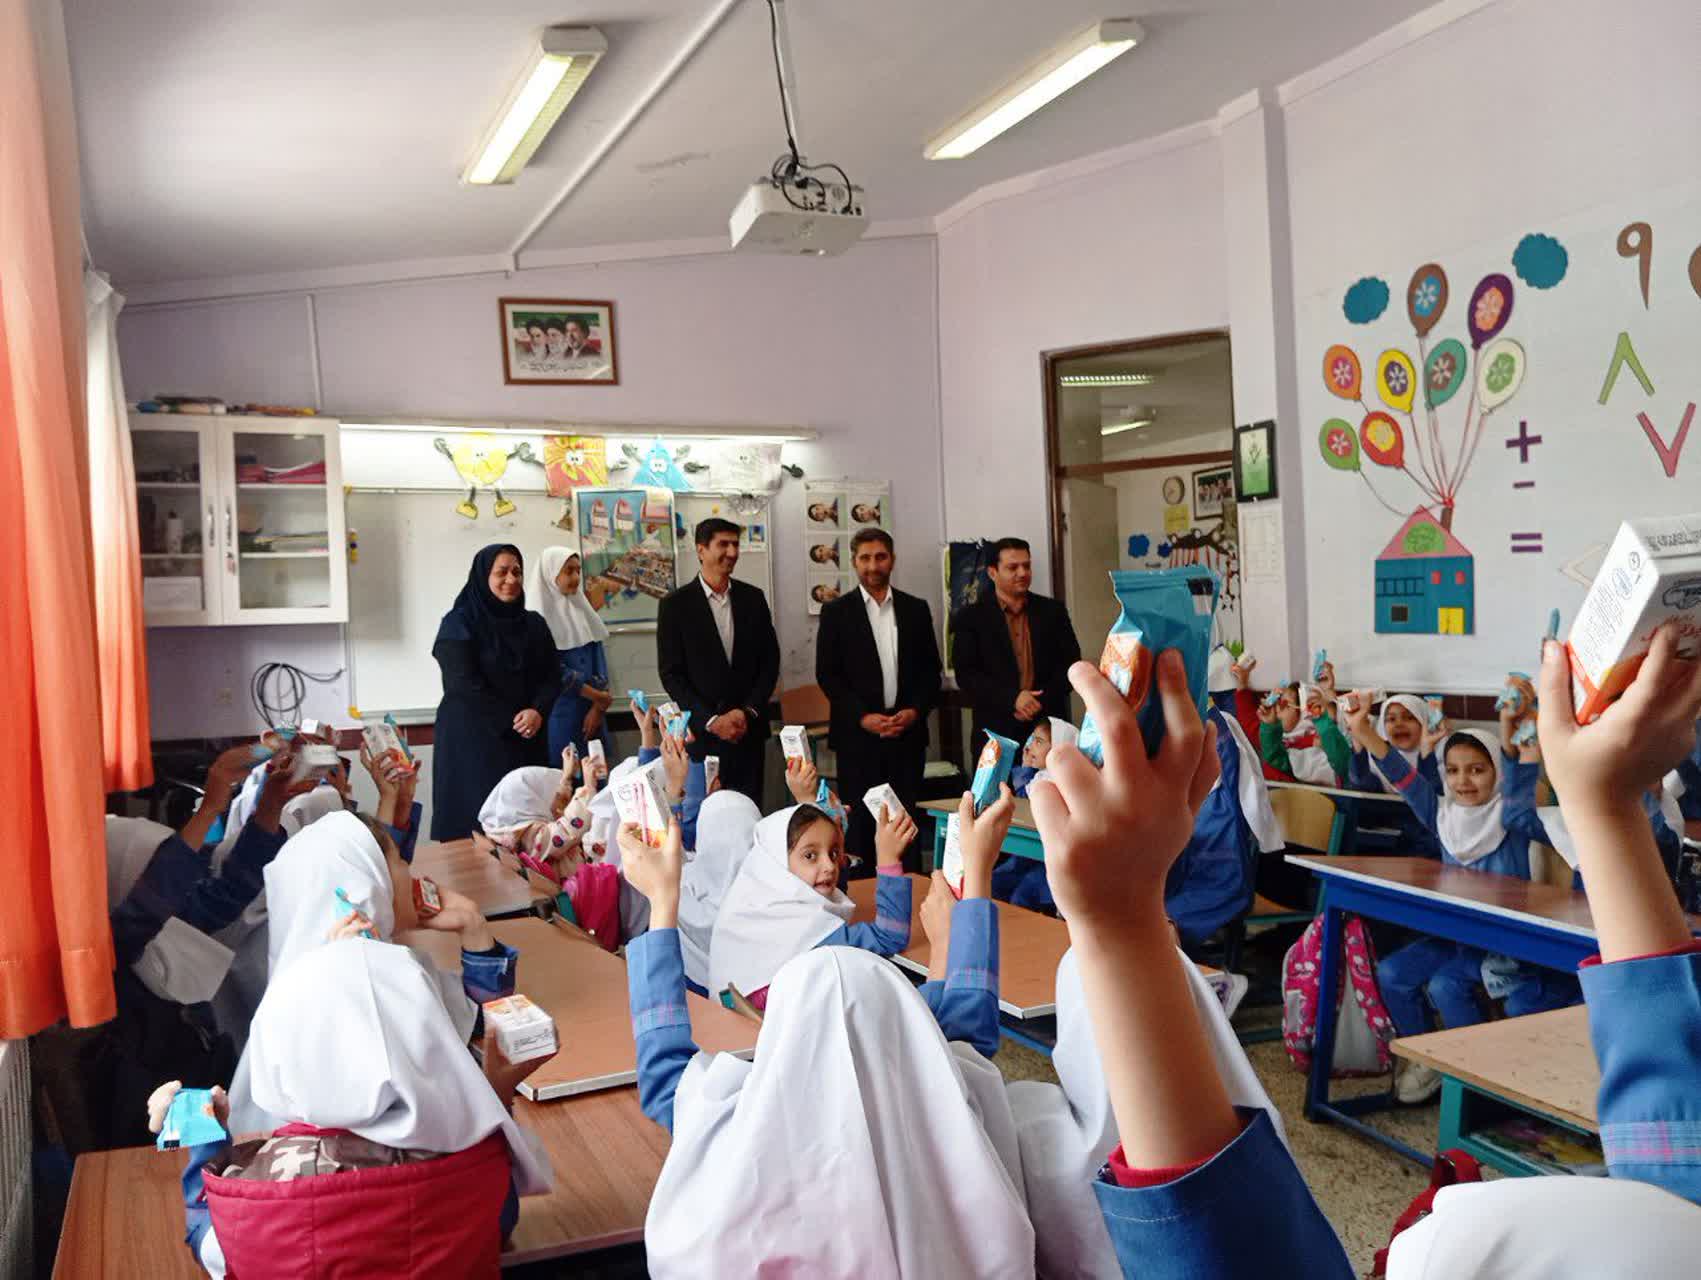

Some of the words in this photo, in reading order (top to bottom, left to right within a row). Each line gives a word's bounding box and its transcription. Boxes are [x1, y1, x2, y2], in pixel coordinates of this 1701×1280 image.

[1617, 222, 1652, 310] ۹
[1598, 332, 1655, 404] ۸
[1637, 402, 1696, 477] ۷
